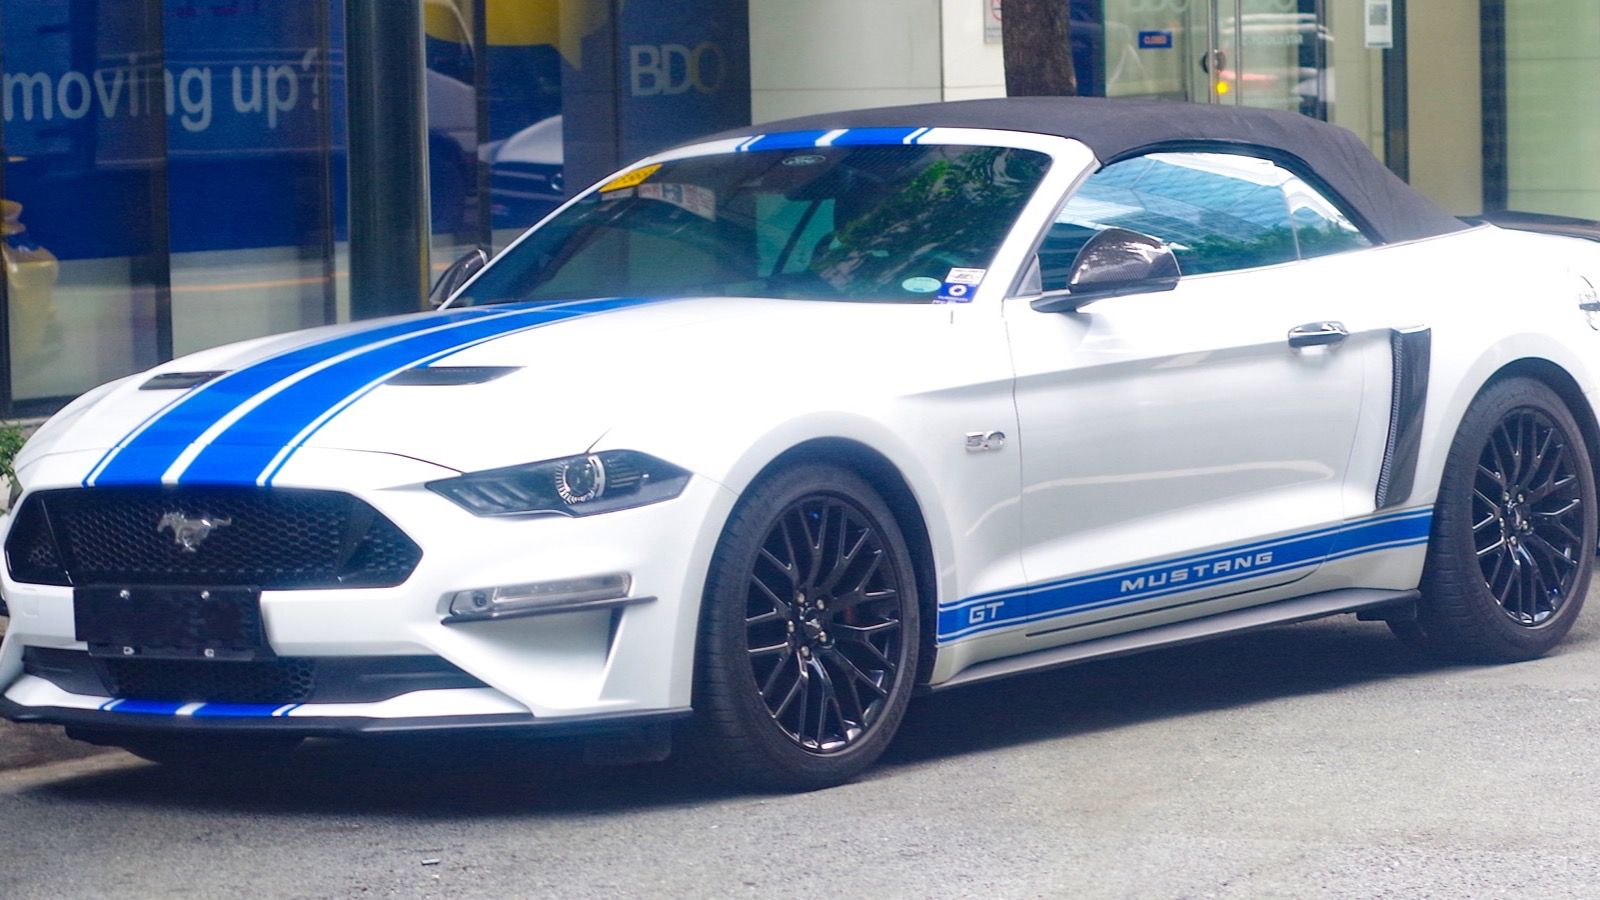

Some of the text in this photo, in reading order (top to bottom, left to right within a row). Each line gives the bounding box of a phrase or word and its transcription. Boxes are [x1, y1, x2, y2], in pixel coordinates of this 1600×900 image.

[629, 41, 726, 97] BDO
[2, 52, 212, 132] moving
[965, 430, 1006, 453] 5.0
[1119, 551, 1274, 593] MUSTANG
[968, 601, 1005, 624] GT
